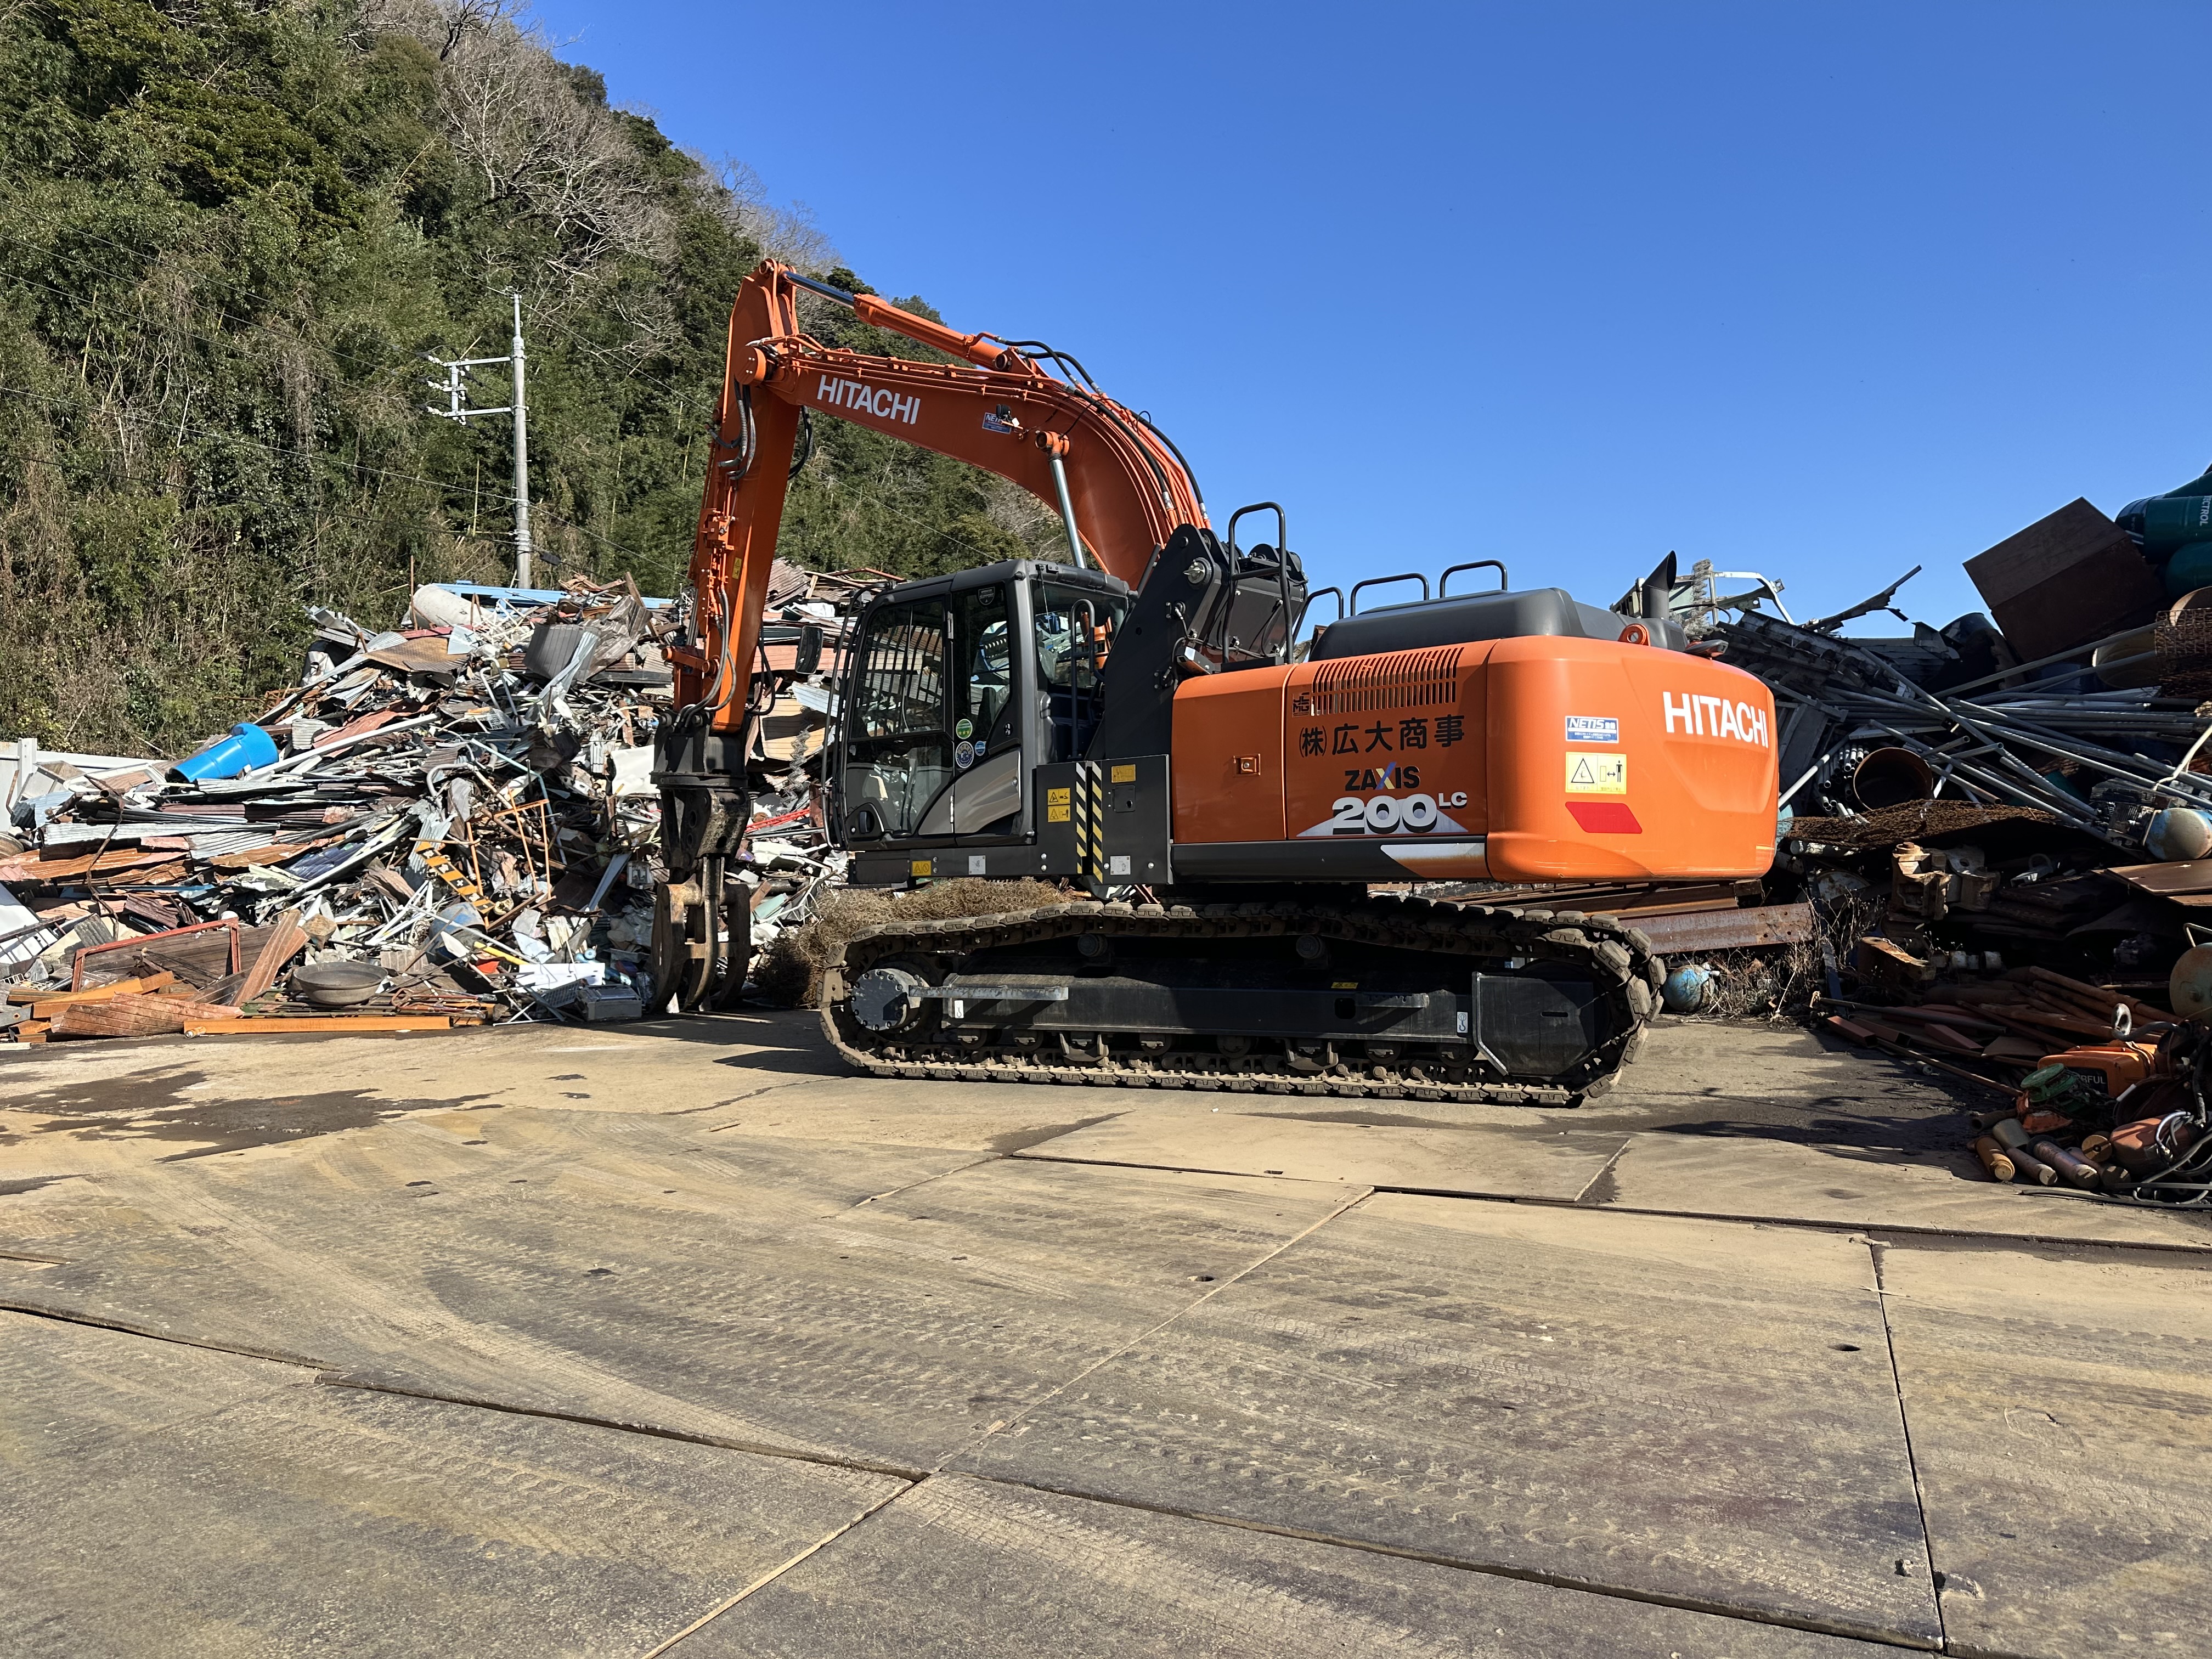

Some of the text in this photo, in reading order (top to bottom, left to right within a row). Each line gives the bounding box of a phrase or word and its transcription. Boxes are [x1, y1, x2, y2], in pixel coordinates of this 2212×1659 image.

[816, 374, 921, 425] HITACHI
[1662, 691, 1769, 748] HITACHI
[1345, 761, 1421, 791] ZAXIS
